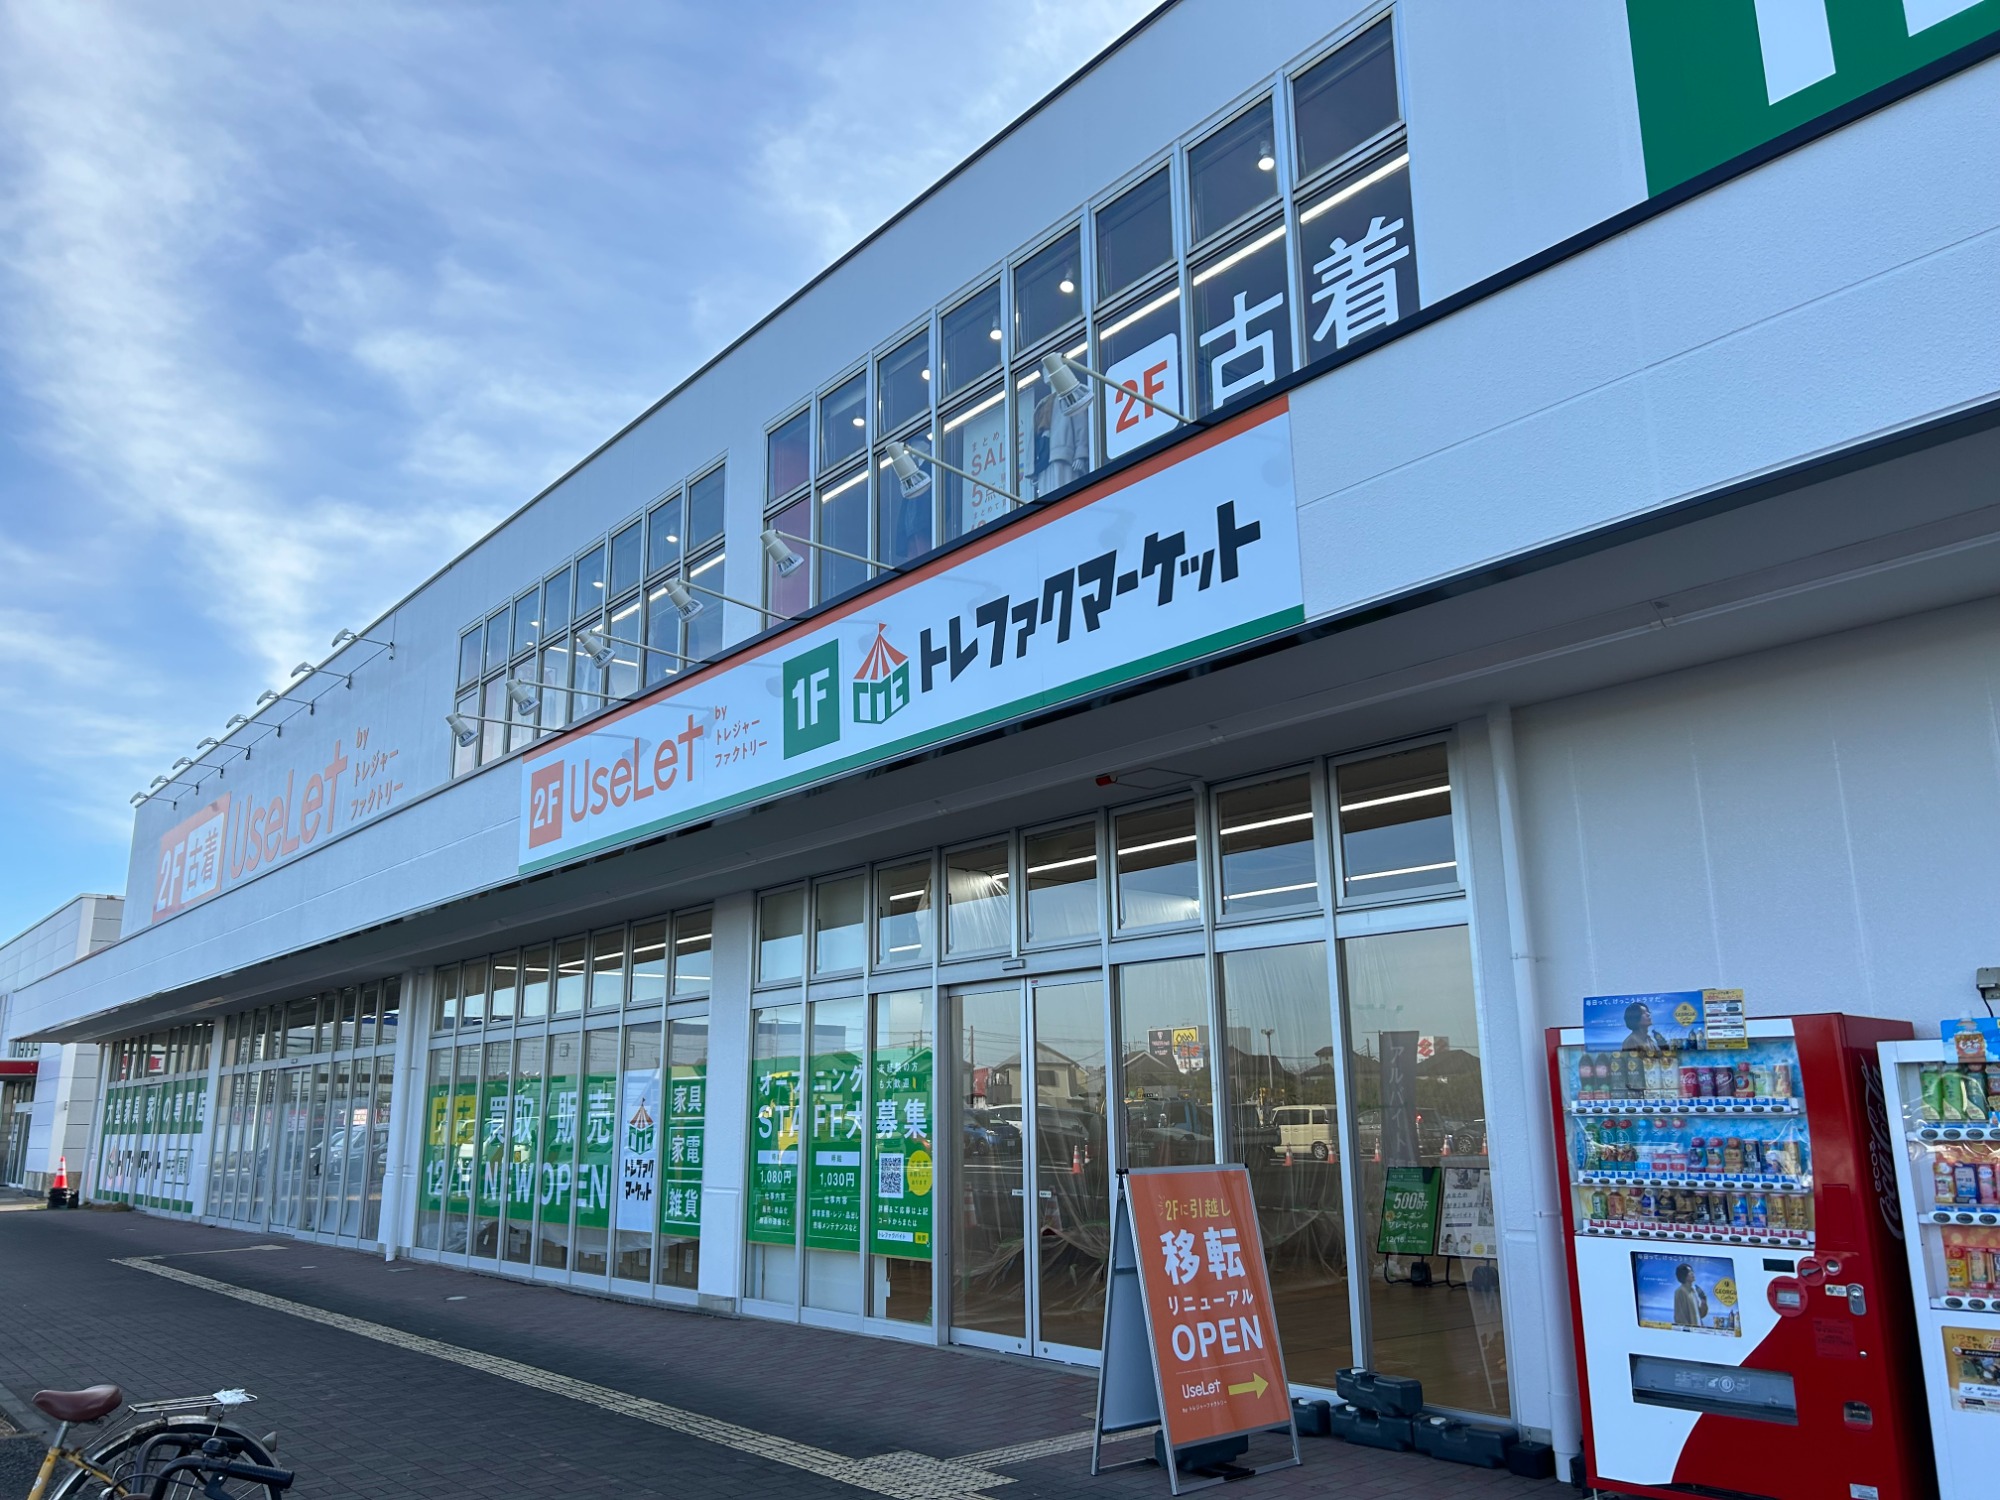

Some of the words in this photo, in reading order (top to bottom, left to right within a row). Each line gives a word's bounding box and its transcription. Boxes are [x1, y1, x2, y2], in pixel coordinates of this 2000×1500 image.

[1115, 359, 1168, 434] 2F
[1199, 216, 1410, 412] 古着
[920, 500, 1261, 694] トレファクマーケット
[714, 705, 727, 720] by
[792, 668, 830, 731] 1F
[356, 727, 369, 750] by
[716, 718, 761, 746] トレジャー
[354, 748, 399, 786] トレジャー
[714, 739, 768, 768] ファクトリー
[533, 779, 560, 829] 2F
[570, 714, 704, 823] UseLet
[350, 781, 404, 821] ファクトリー
[156, 846, 185, 913] 2F
[185, 827, 219, 891] 古着
[230, 739, 348, 878] UseLet
[673, 1085, 702, 1114] 家具
[671, 1134, 700, 1163] 家電
[625, 1159, 655, 1179] トレファク
[760, 1170, 792, 1184] 1,080円
[820, 1172, 855, 1187] 1,030円
[542, 1161, 609, 1209] OPEN
[625, 1181, 652, 1201] マーケット
[668, 1188, 698, 1218] 雑貨
[1164, 1198, 1231, 1221] 2Fに引越し
[1160, 1226, 1246, 1286] 移転
[1168, 1288, 1254, 1316] リニューアル
[1171, 1314, 1264, 1362] OPEN
[1182, 1379, 1221, 1399] UseLet
